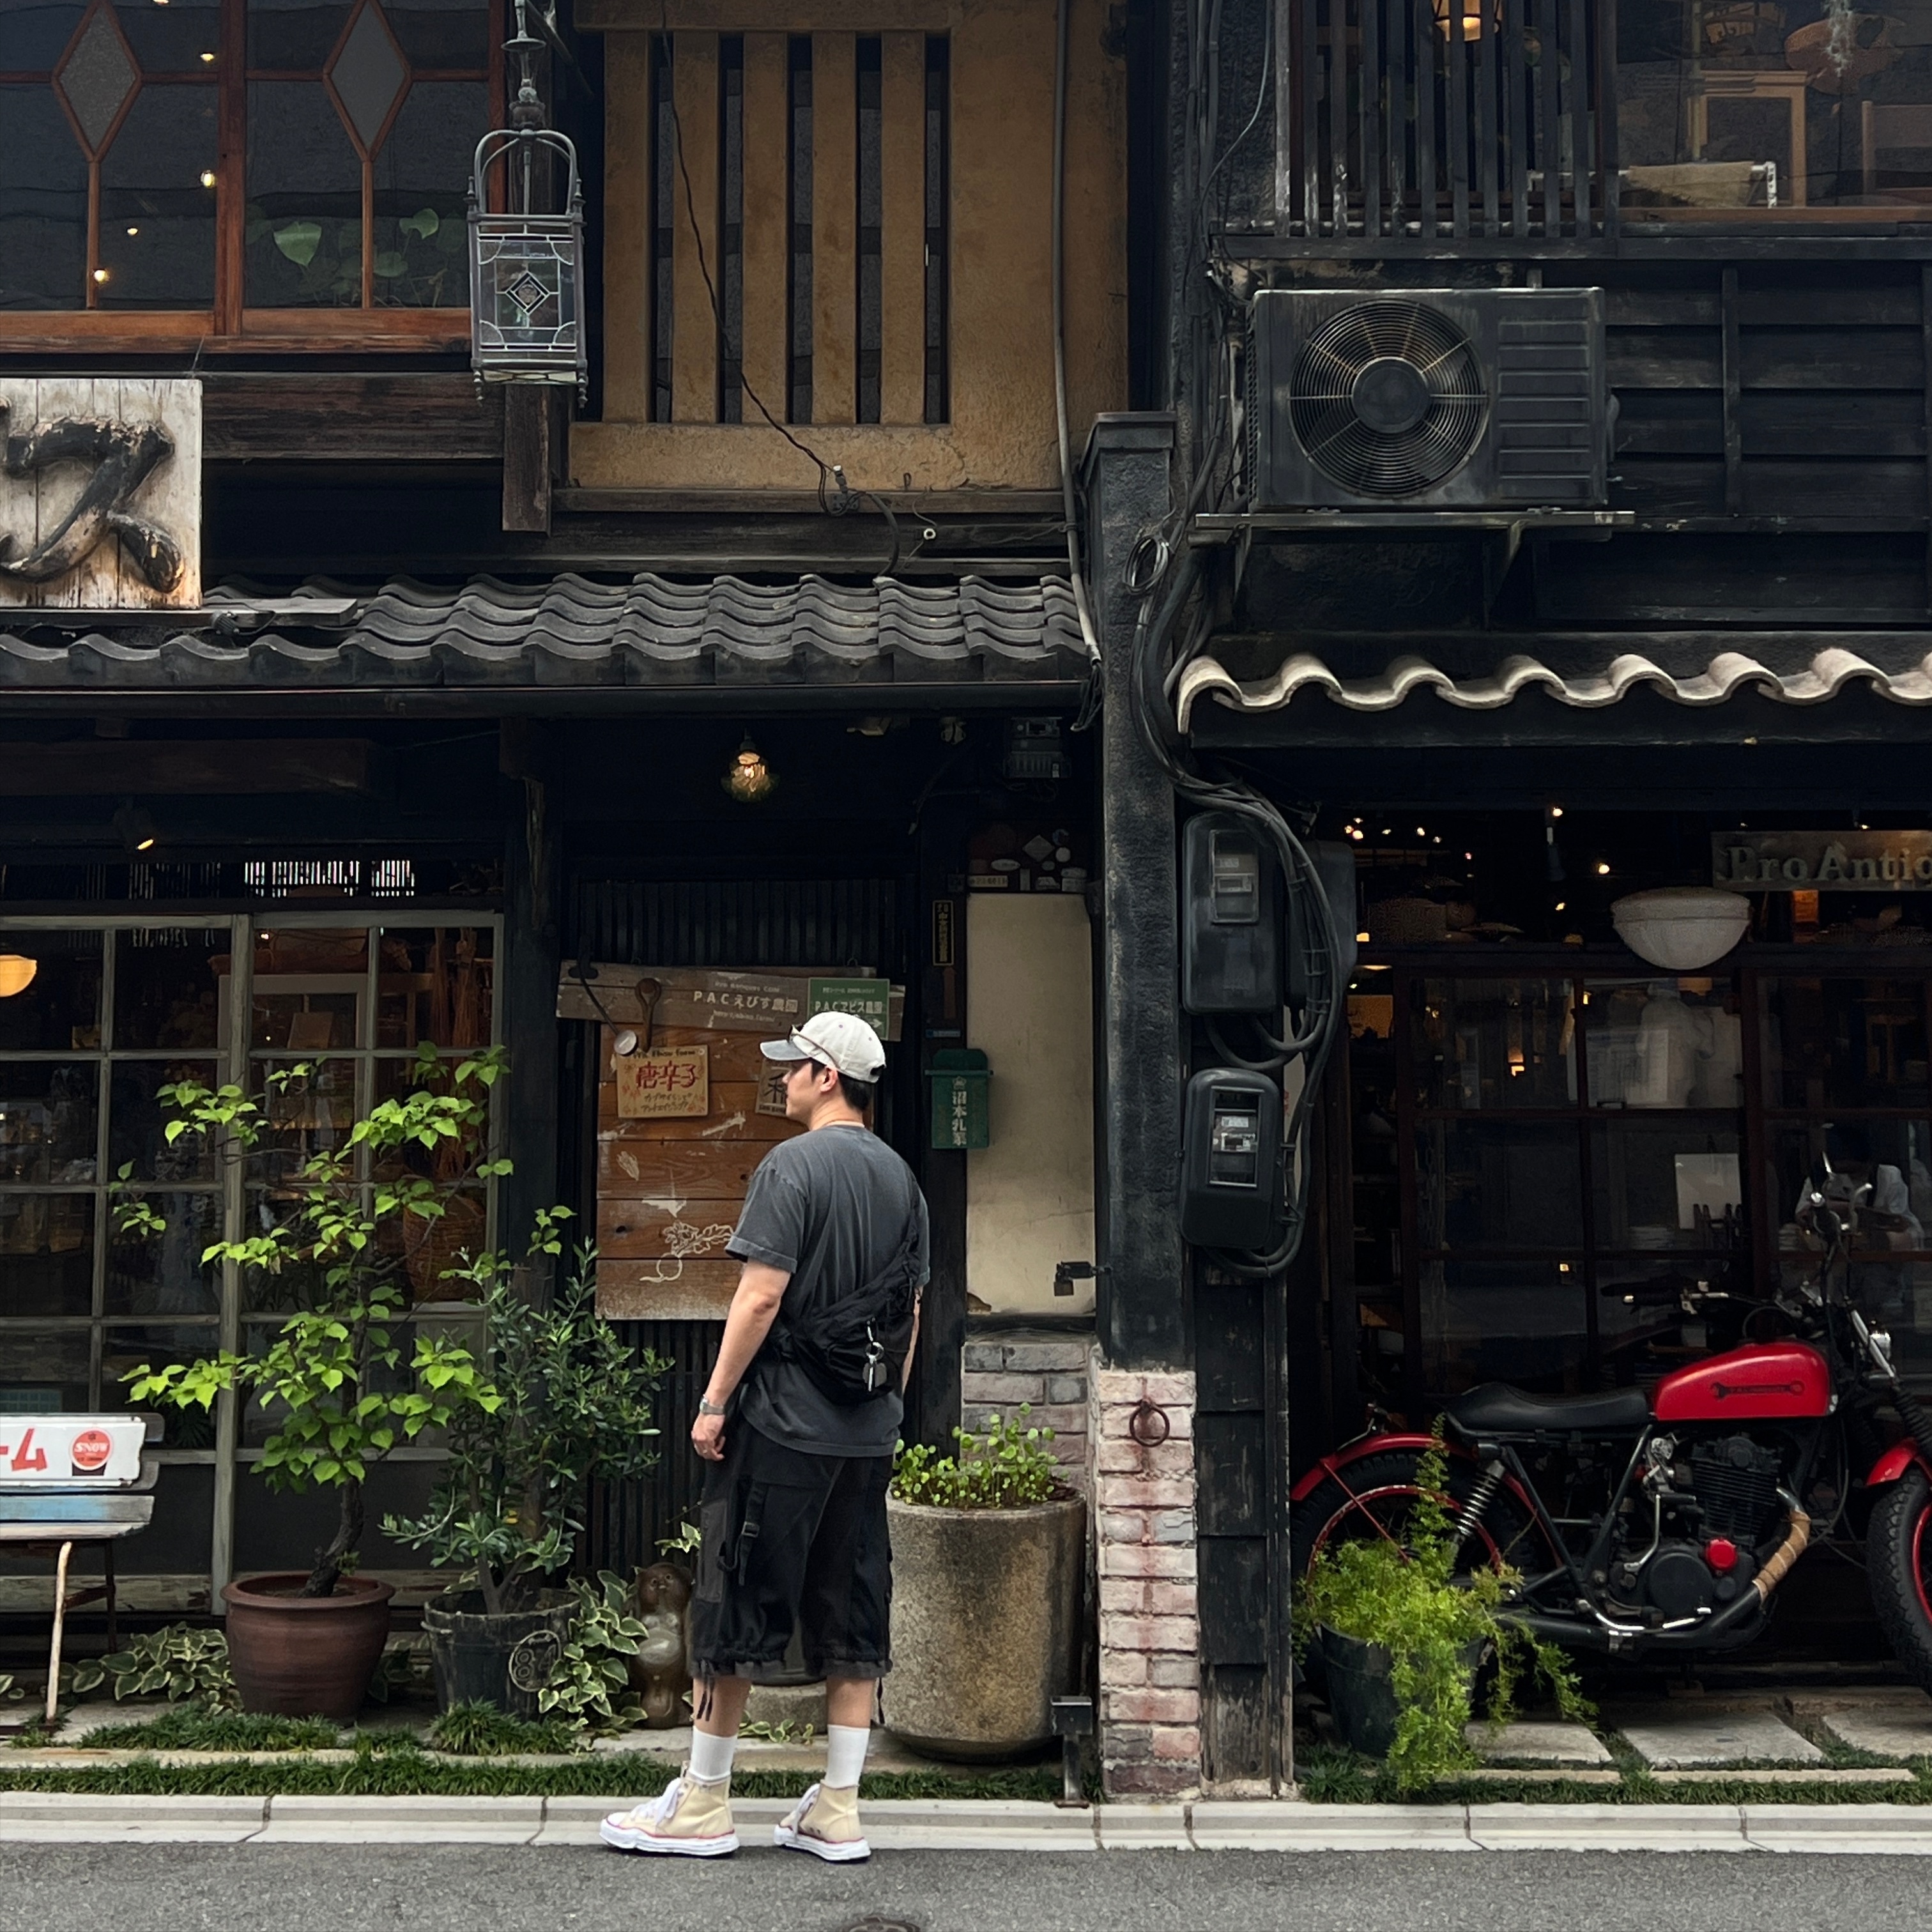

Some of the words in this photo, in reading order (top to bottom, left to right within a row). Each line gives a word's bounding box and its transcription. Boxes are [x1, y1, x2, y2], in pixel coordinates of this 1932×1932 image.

[1728, 845, 1808, 882] Pro
[636, 1060, 698, 1091] 唐辛子
[74, 1442, 108, 1453] SNOW
